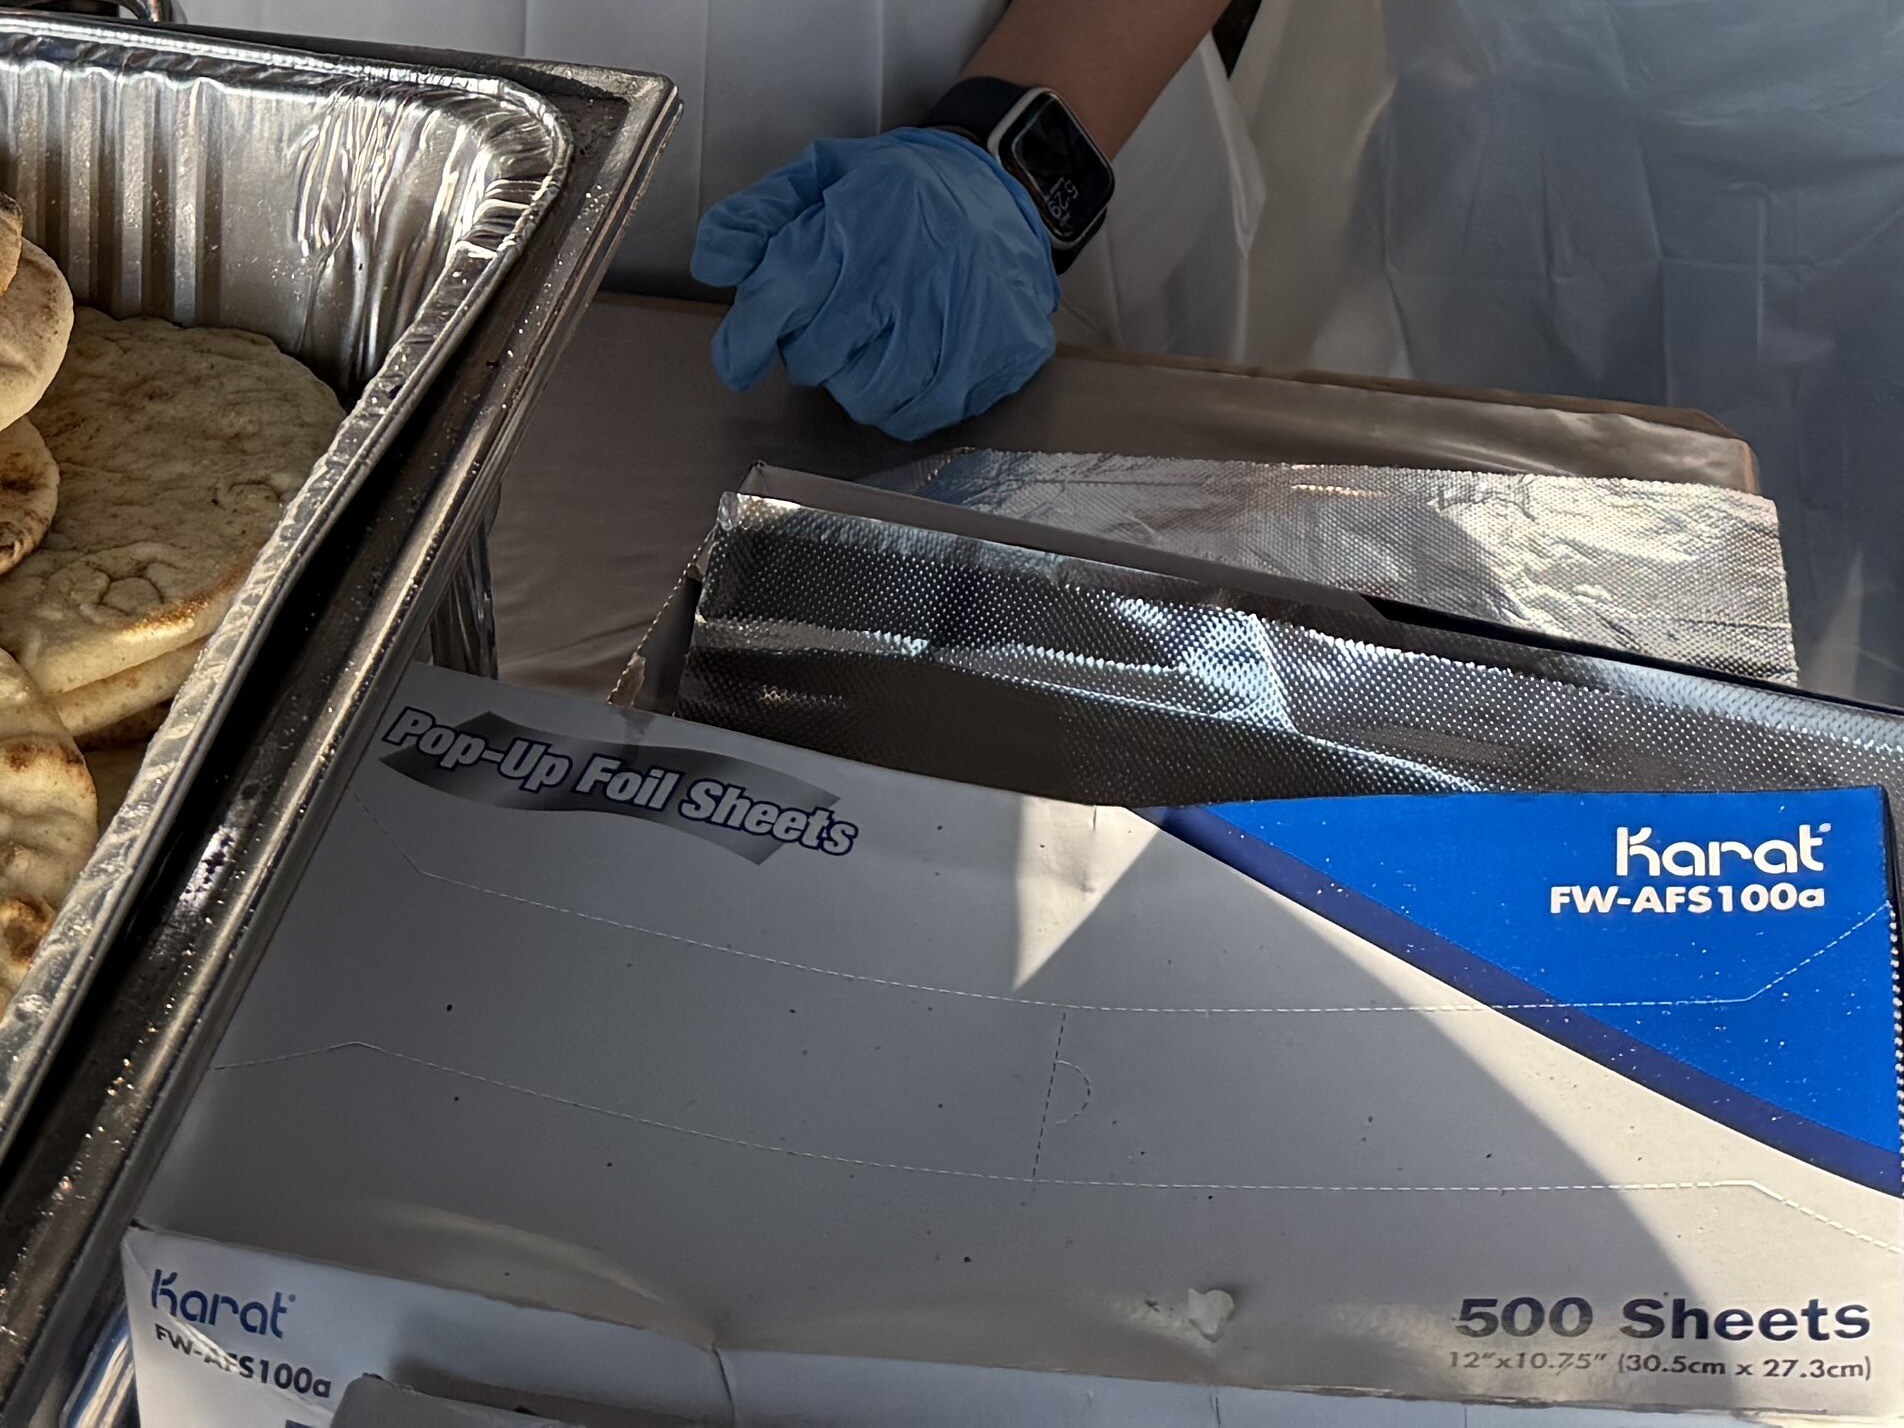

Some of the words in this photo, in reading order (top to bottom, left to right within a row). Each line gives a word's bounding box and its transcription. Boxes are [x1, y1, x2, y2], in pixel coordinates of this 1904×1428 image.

[383, 706, 573, 793] Pop-Up
[572, 752, 686, 812] Foil
[678, 775, 860, 857] Sheets
[1616, 823, 1825, 877] Karat
[1549, 882, 1826, 914] FW-AFS100a
[151, 1268, 284, 1339] Karat
[1454, 1296, 1594, 1338] 500
[1619, 1297, 1872, 1341] Sheets
[1618, 1352, 1726, 1376] (30.5cm
[1735, 1363, 1754, 1377] x
[1762, 1356, 1873, 1382] 27.3cm)
